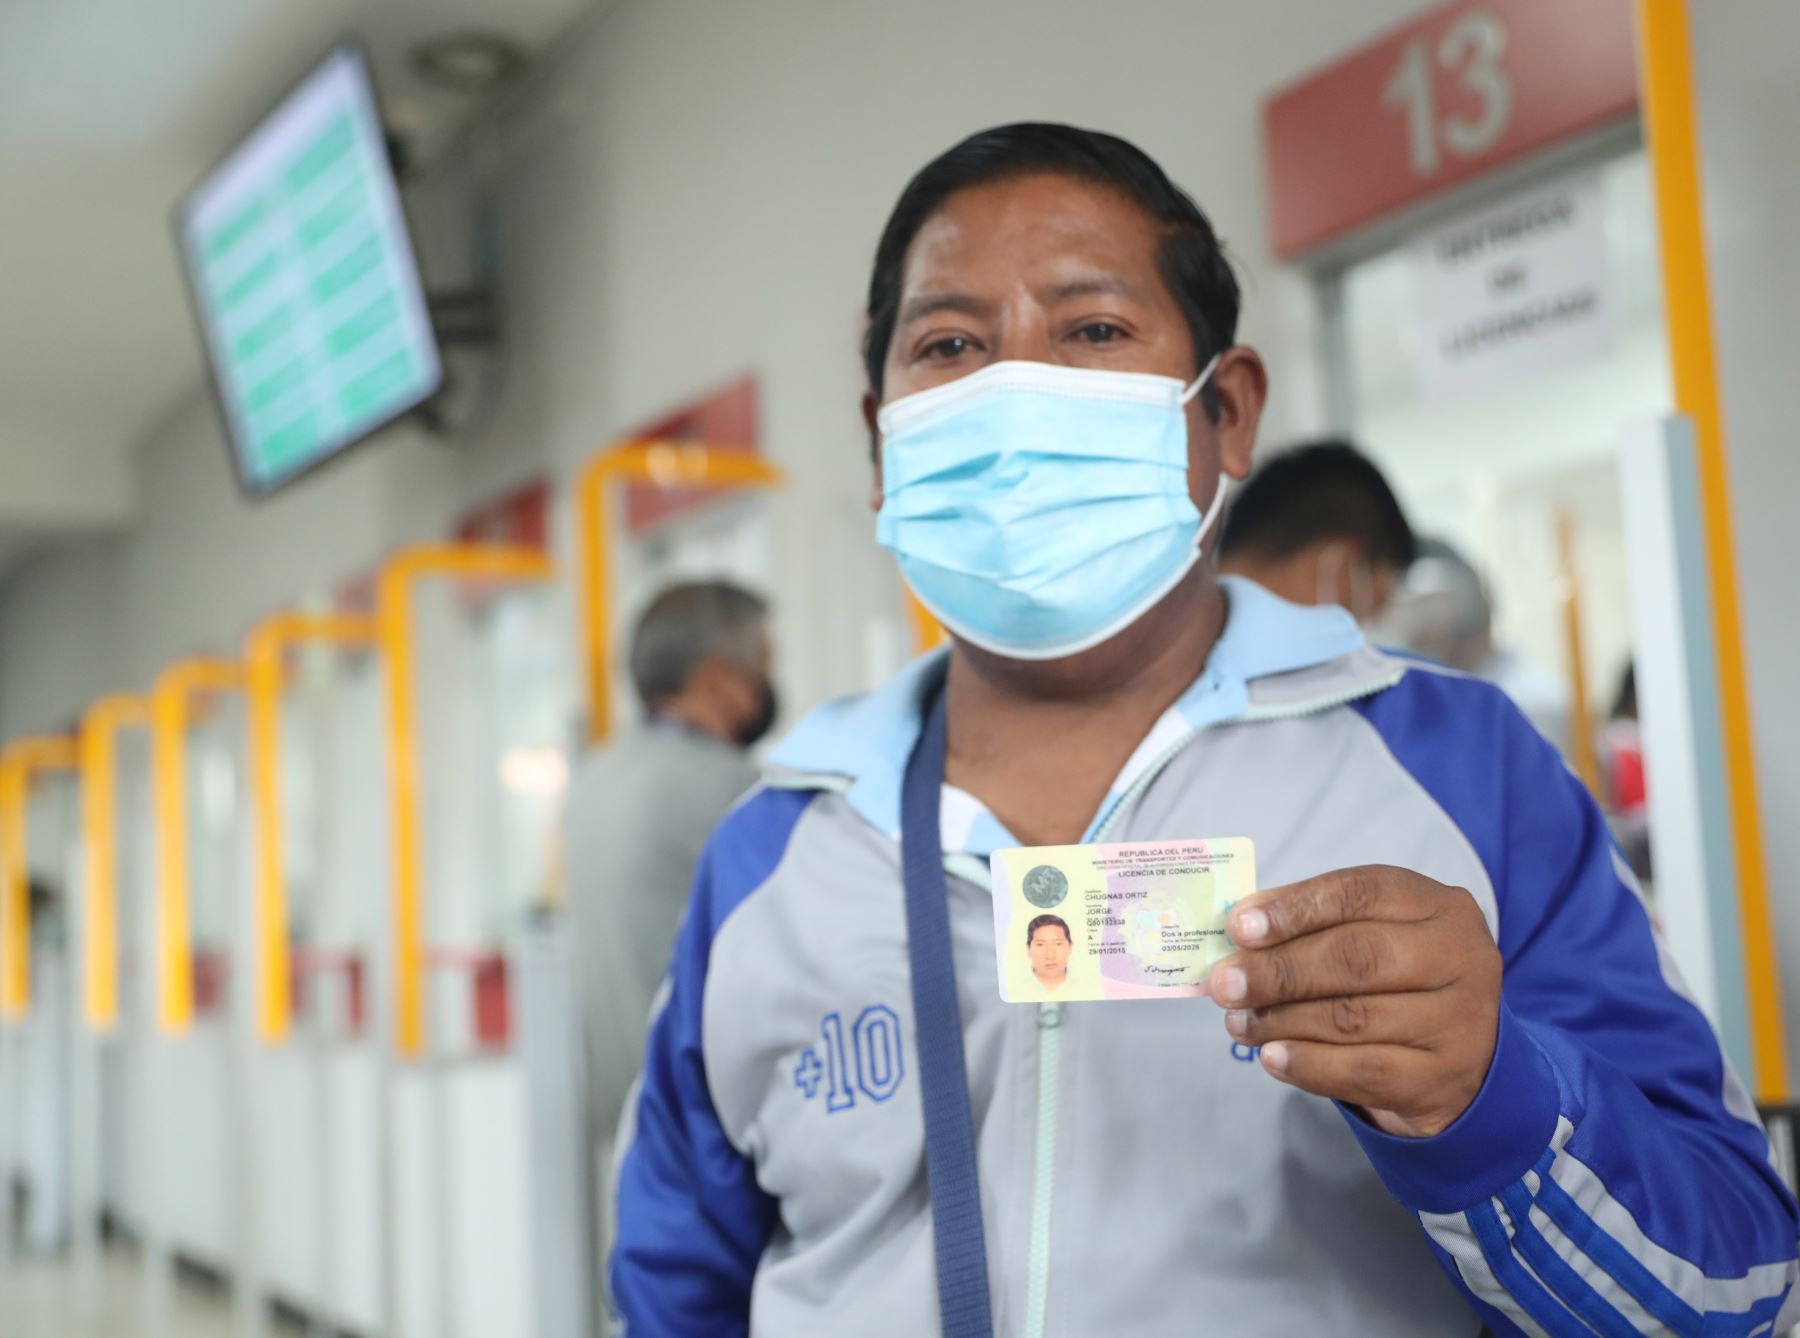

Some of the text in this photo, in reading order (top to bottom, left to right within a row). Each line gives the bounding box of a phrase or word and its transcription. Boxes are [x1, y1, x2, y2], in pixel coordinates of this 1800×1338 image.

[1380, 10, 1514, 178] 13
[1118, 850, 1163, 858] REPUBLICA
[1165, 848, 1179, 856] DEL
[1118, 869, 1154, 878] LICENCIA
[1169, 867, 1209, 875] CONDUCIR
[1125, 891, 1148, 899] ORTIZ
[1184, 929, 1225, 937] profesional
[794, 1003, 905, 1114] +10
